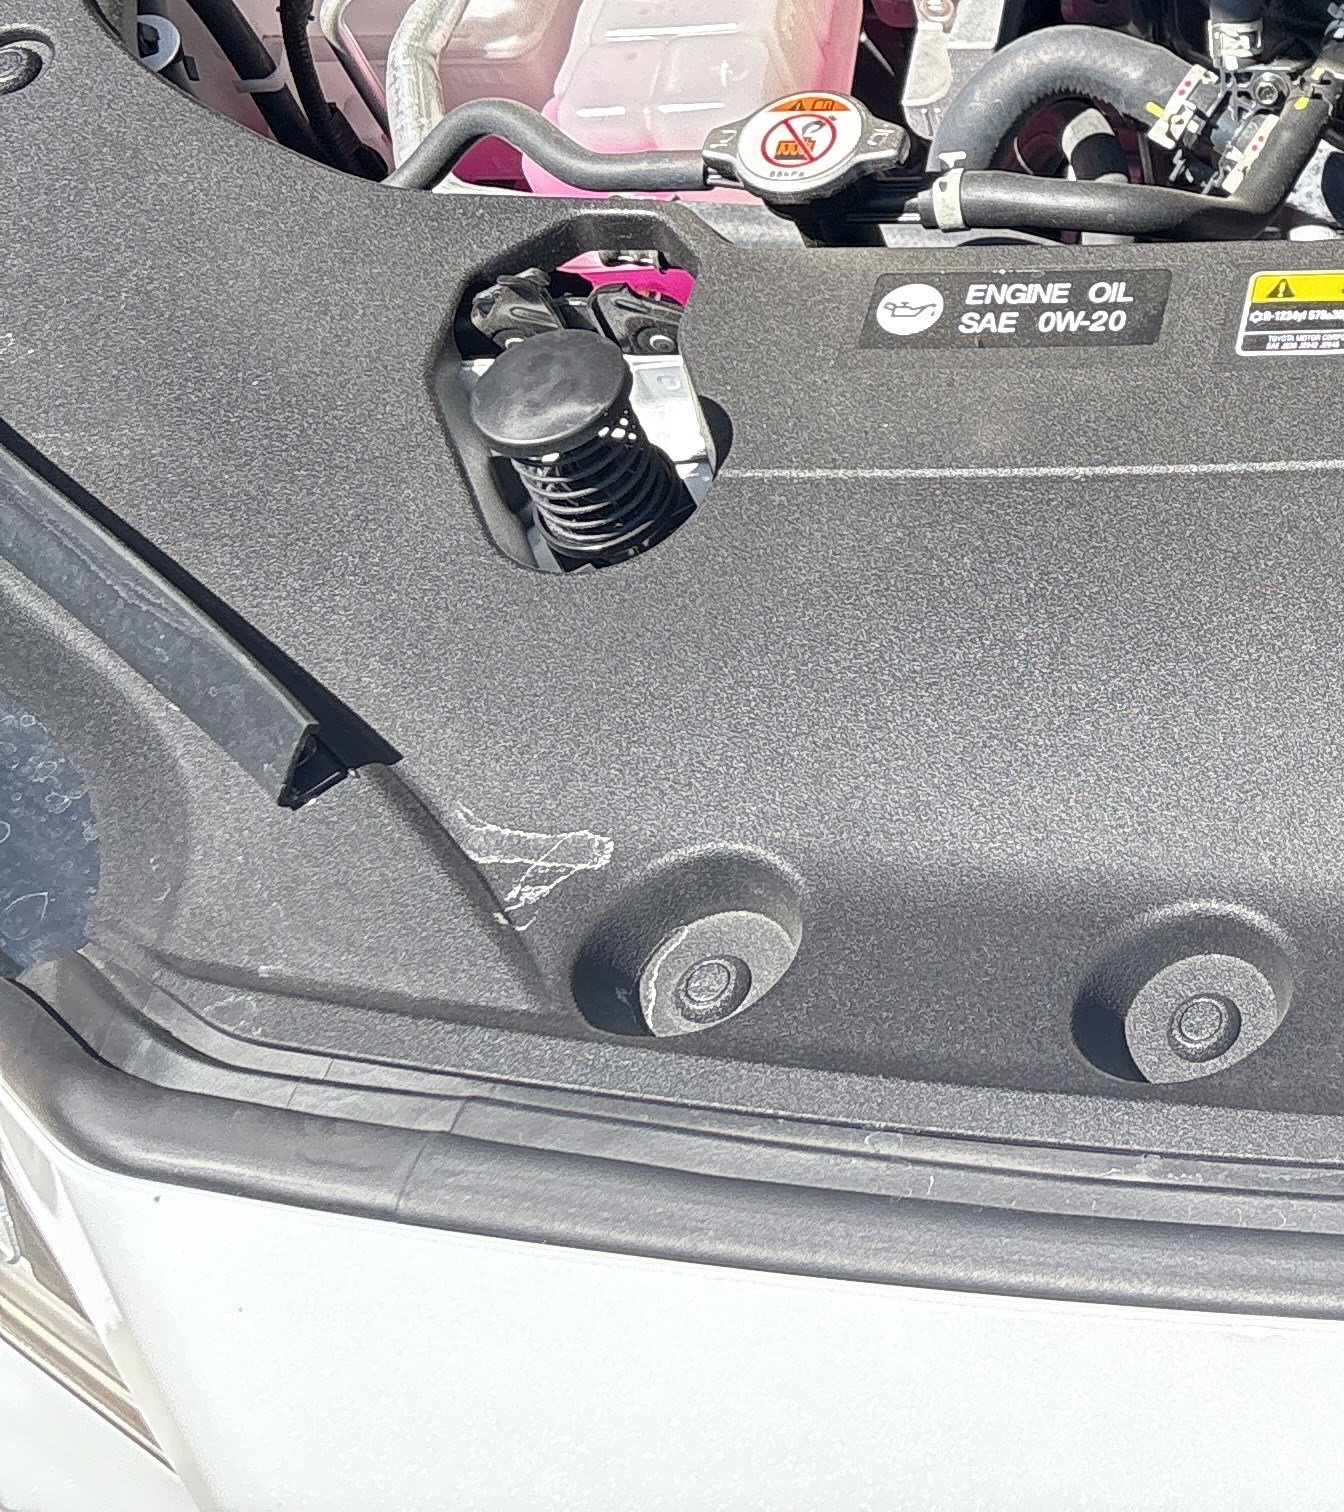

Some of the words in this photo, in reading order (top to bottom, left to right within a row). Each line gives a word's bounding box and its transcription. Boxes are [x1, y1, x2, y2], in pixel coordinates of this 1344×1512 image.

[965, 283, 1071, 304] ENGINE
[1088, 281, 1134, 303] OIL
[958, 311, 1019, 334] SAE
[1038, 310, 1127, 332] 0W-20
